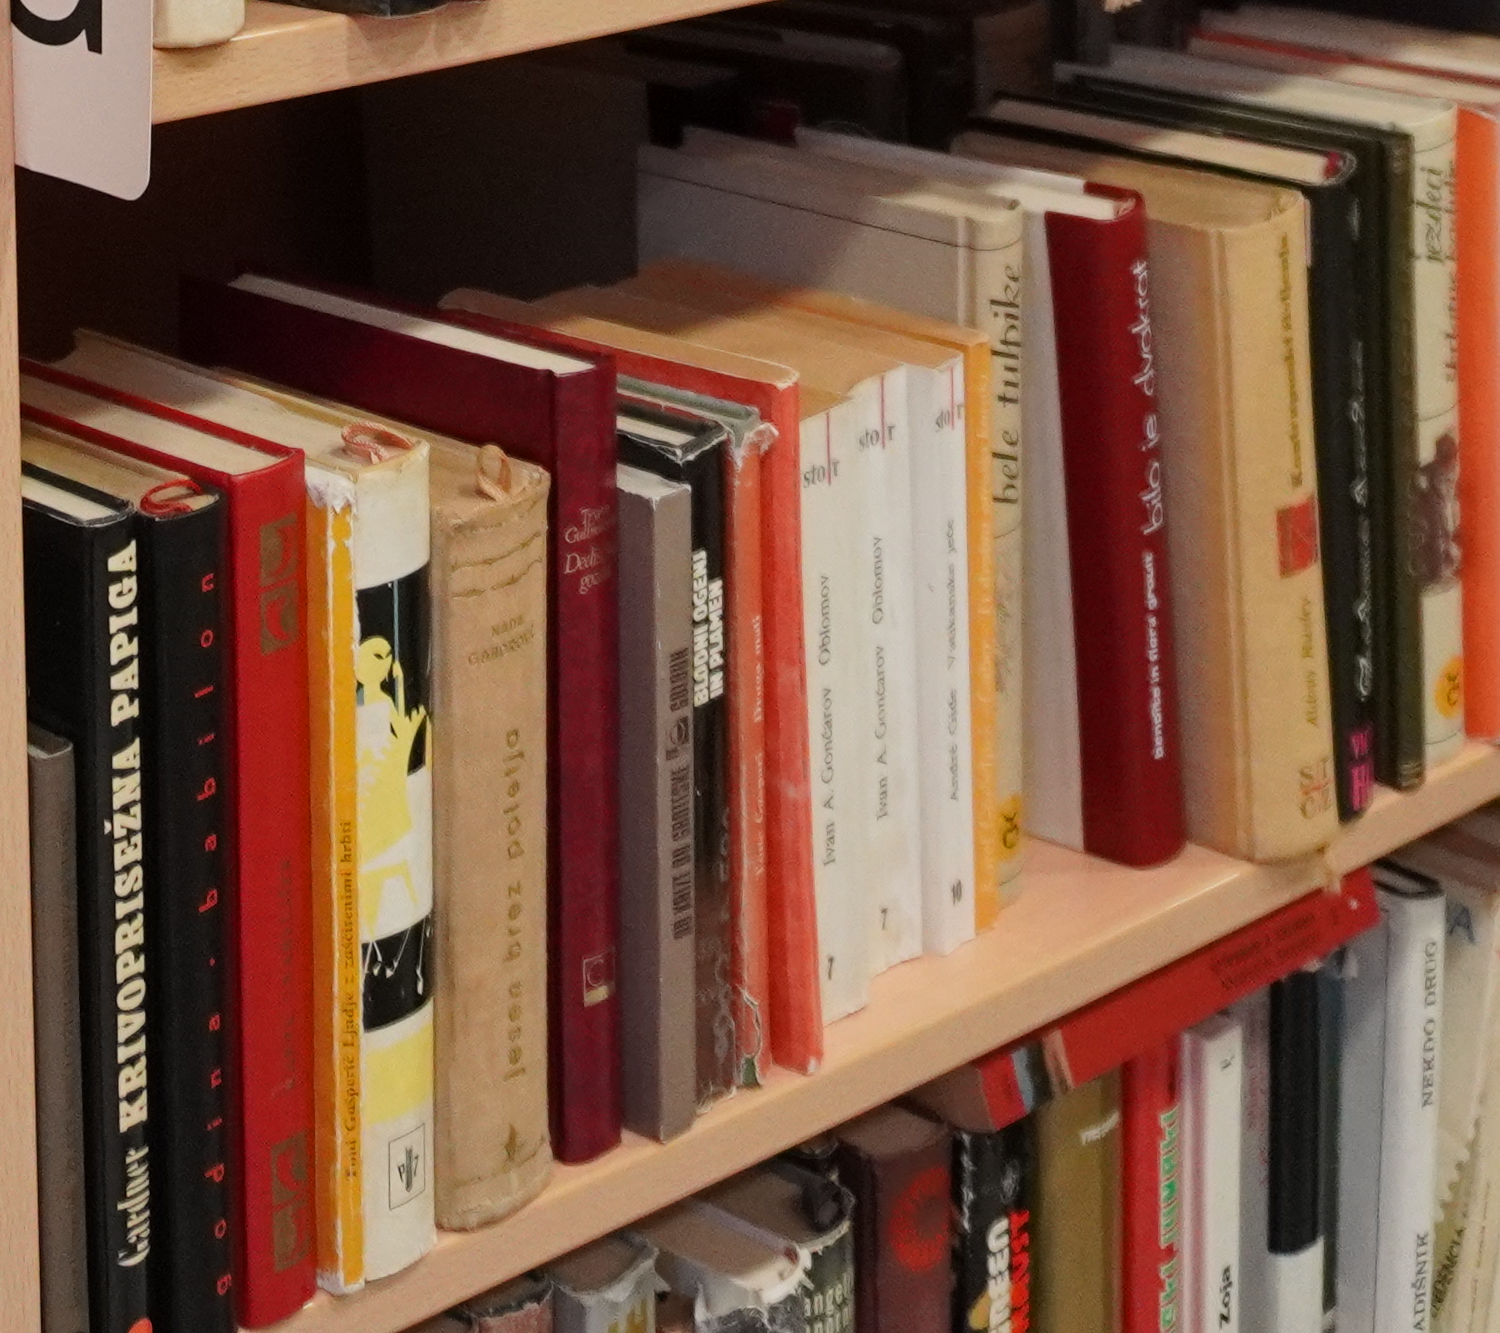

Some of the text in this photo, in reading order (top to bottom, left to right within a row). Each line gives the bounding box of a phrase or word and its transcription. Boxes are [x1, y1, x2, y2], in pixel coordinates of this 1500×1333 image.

[991, 263, 1027, 507] bele tulpike
[1131, 259, 1162, 398] dvakrat
[1140, 460, 1164, 532] bilo
[692, 614, 709, 706] BLODNI
[705, 579, 723, 699] IN PLAMEN
[105, 540, 152, 1267] Gardner KRIVOPRISEŽNA PAPIGA
